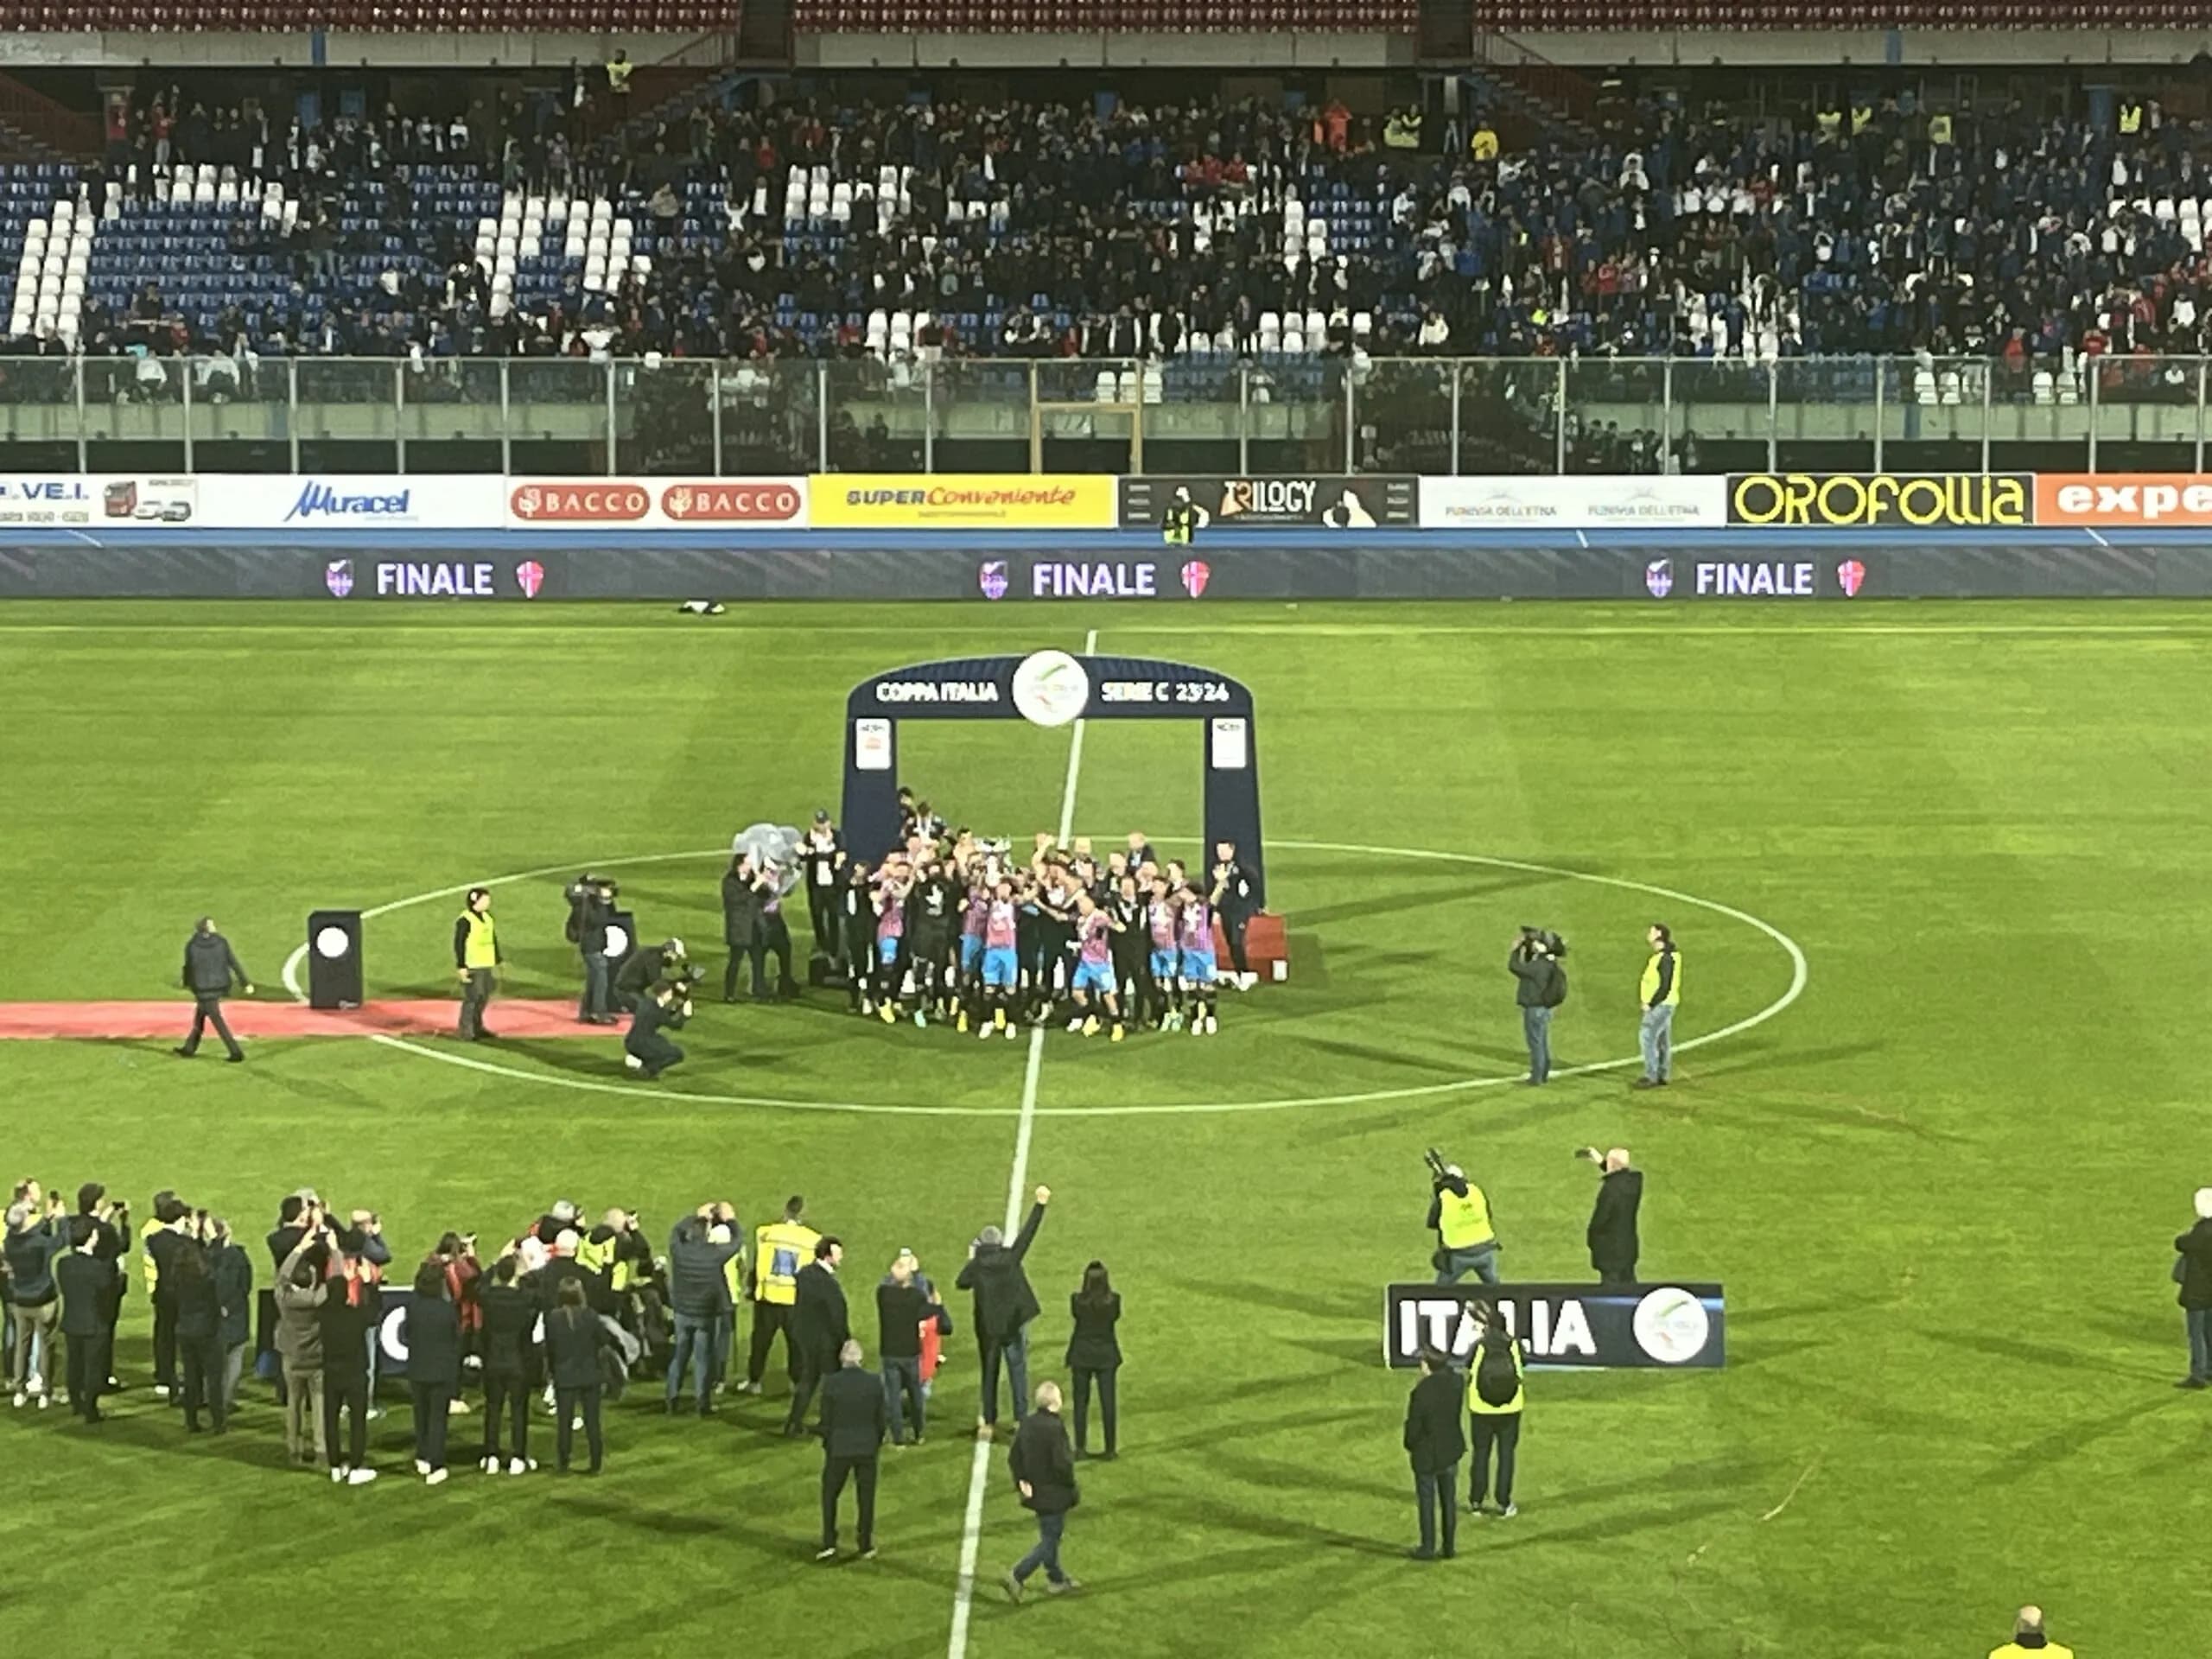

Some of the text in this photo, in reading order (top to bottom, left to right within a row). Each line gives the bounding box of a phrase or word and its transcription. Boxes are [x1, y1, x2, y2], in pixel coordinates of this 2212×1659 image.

[545, 493, 645, 512] BACCO
[696, 492, 795, 512] BACCO
[1220, 480, 1316, 516] TRILOGY
[377, 563, 493, 594] FINALE
[1033, 563, 1155, 595] FINALE
[1696, 563, 1813, 594] FINALE
[876, 682, 999, 702] COPPA ITALIA
[1102, 682, 1153, 702] SERIE
[1155, 682, 1169, 702] C
